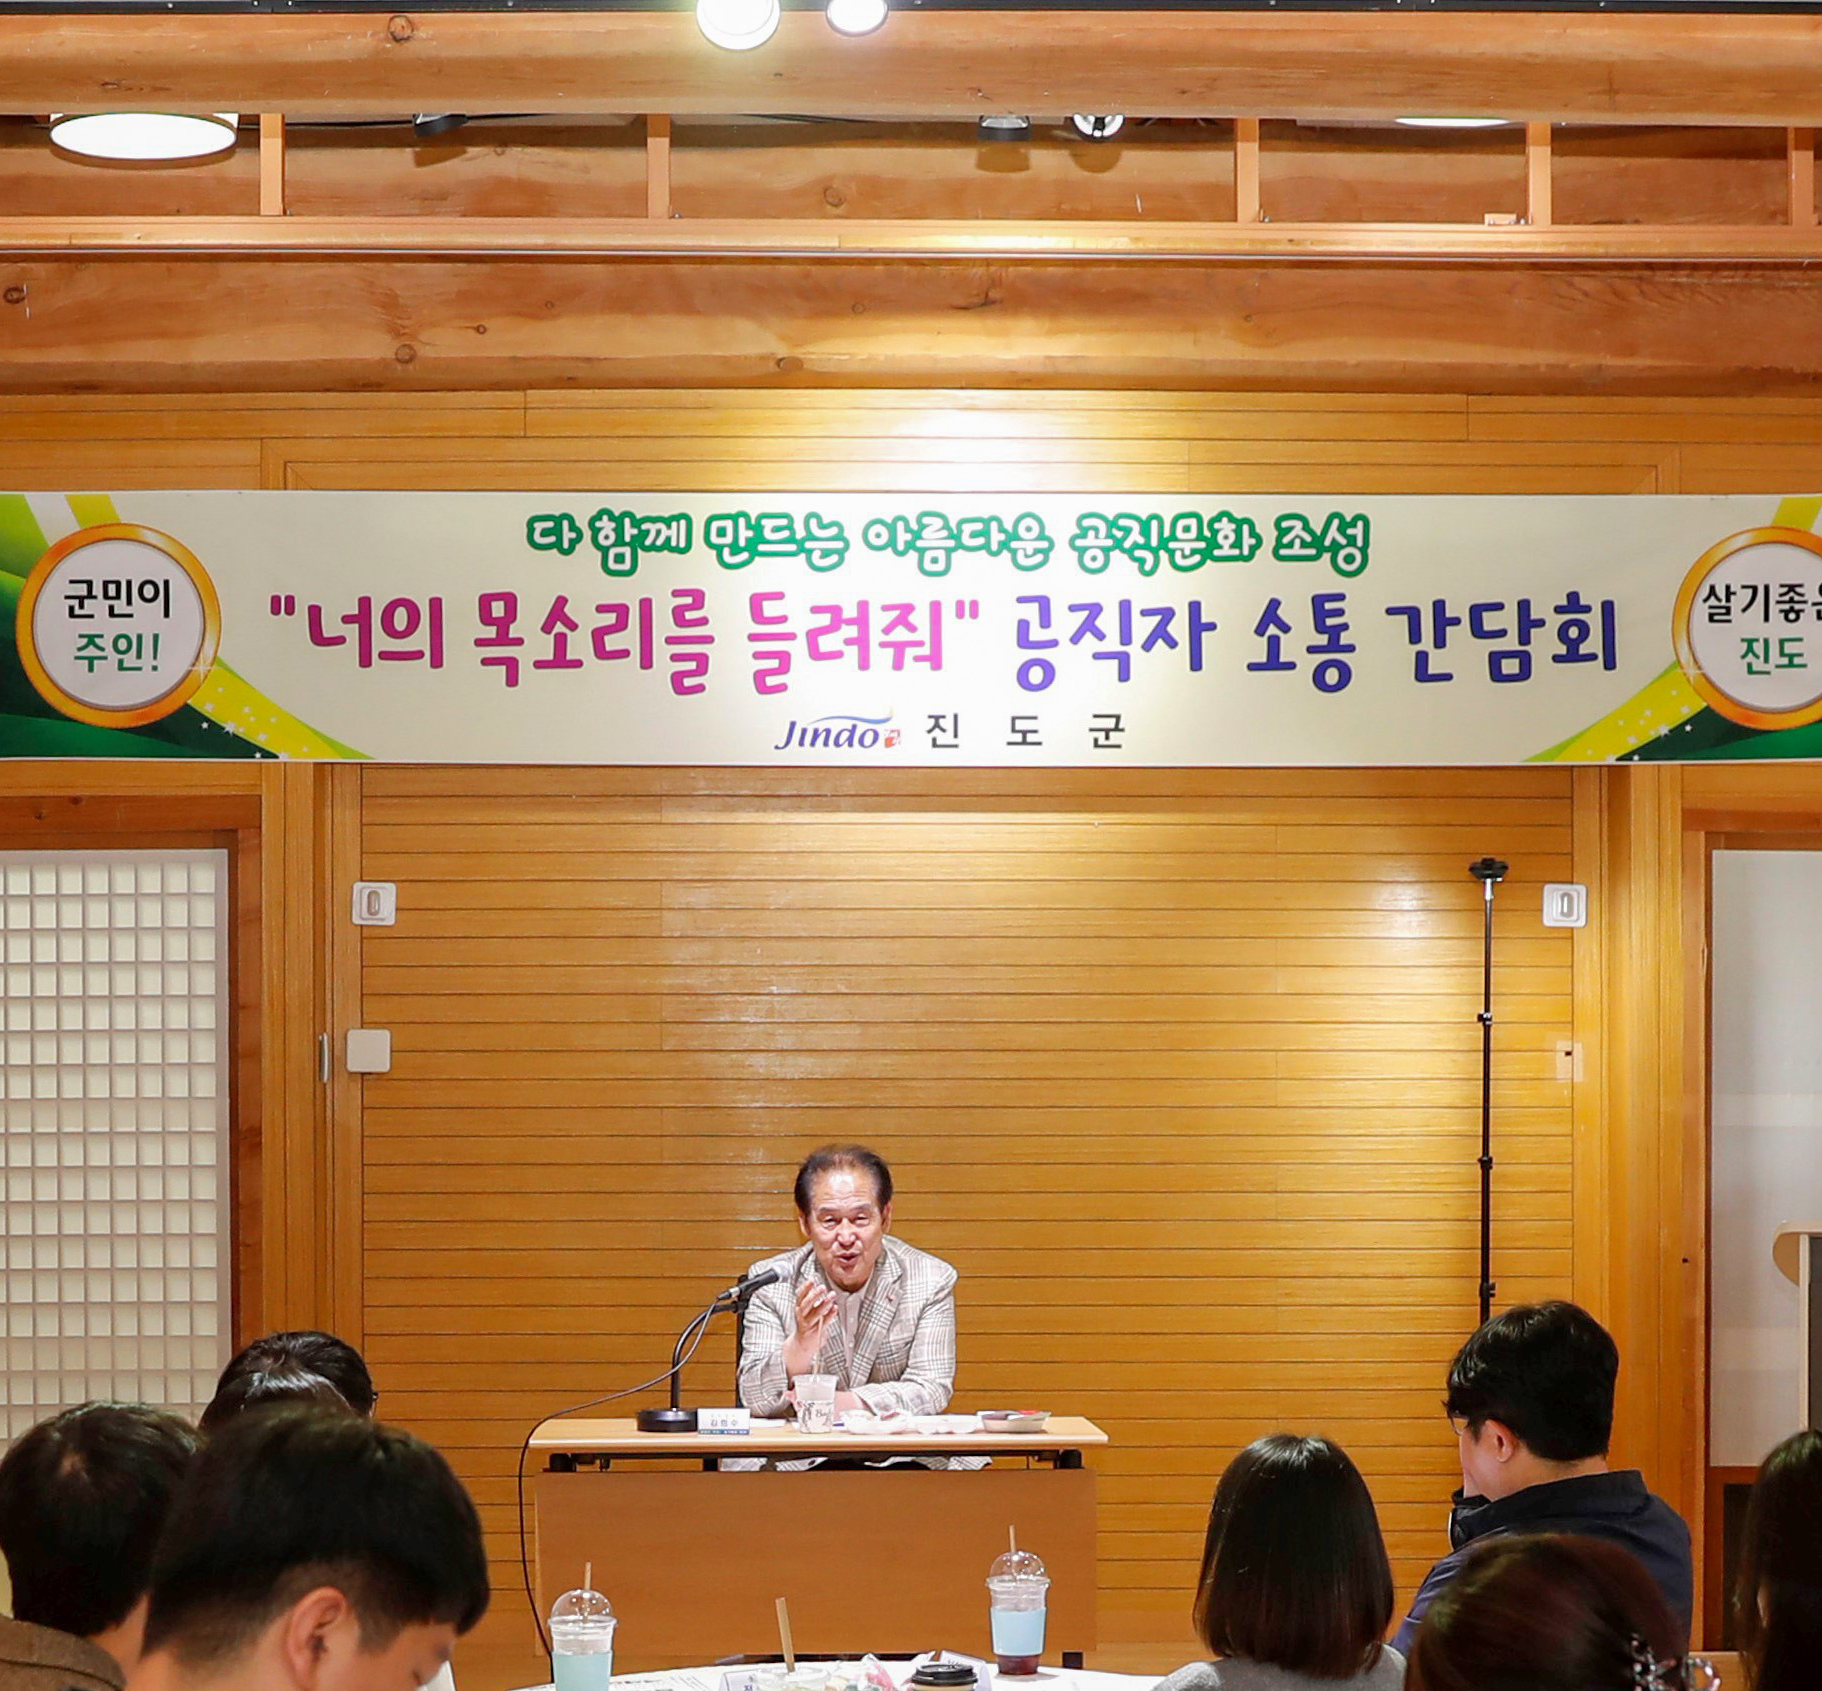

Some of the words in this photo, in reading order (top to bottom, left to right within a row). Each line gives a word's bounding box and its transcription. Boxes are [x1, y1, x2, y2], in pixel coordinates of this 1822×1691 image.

[525, 512, 581, 556] 다
[589, 506, 691, 577] 함께
[702, 510, 849, 576] 만드는
[867, 510, 1055, 577] 아름다운
[1069, 509, 1263, 576] 공직문화
[1274, 510, 1371, 577] 조성
[64, 578, 172, 621] 군민이
[74, 632, 160, 673] 주인!
[269, 592, 443, 672] "너의
[473, 589, 715, 698] 목소리를
[747, 589, 979, 697] 들려줘"
[1014, 593, 1219, 692] 공직자
[1245, 590, 1358, 694] 소통
[1385, 590, 1620, 684] 간담회
[1738, 635, 1809, 675] 진도
[773, 709, 883, 751] Jindo
